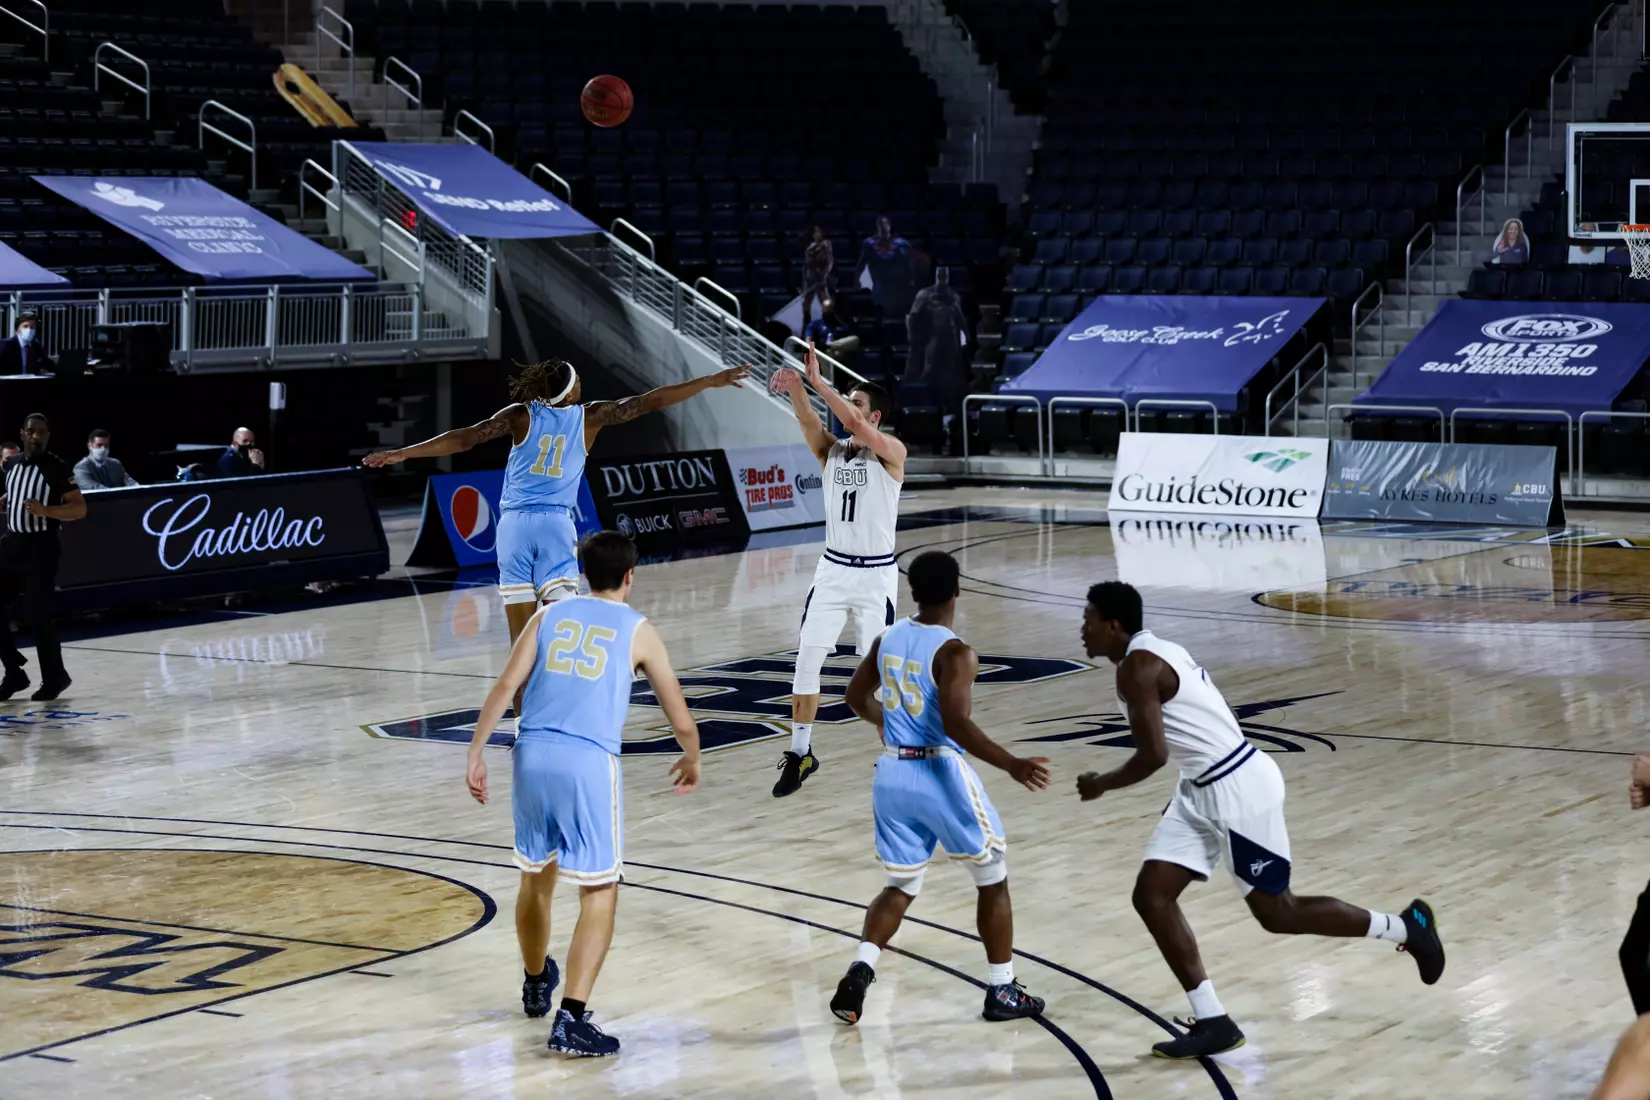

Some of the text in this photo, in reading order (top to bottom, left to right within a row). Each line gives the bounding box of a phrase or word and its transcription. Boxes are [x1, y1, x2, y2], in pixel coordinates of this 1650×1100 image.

[139, 215, 257, 229] RIVERSIDE
[163, 228, 265, 241] MEDICAL
[188, 241, 263, 254] CLINIC
[1153, 326, 1223, 340] Creek
[1511, 319, 1586, 333] FOX
[1420, 362, 1598, 376] SAN BERNARDINO
[1461, 356, 1569, 367] RIVERSIDE
[530, 434, 566, 478] 11
[600, 457, 716, 497] DUTTON
[747, 464, 785, 485] Bud's
[834, 467, 867, 486] CBU
[745, 485, 793, 512] TIRE PROS
[1118, 474, 1307, 508] GuideStone
[1522, 484, 1547, 494] CBU
[841, 490, 857, 522] 11
[634, 507, 730, 533] BUICK GMC
[142, 494, 325, 570] Cadillac
[546, 618, 617, 680] 25
[882, 653, 924, 717] 55
